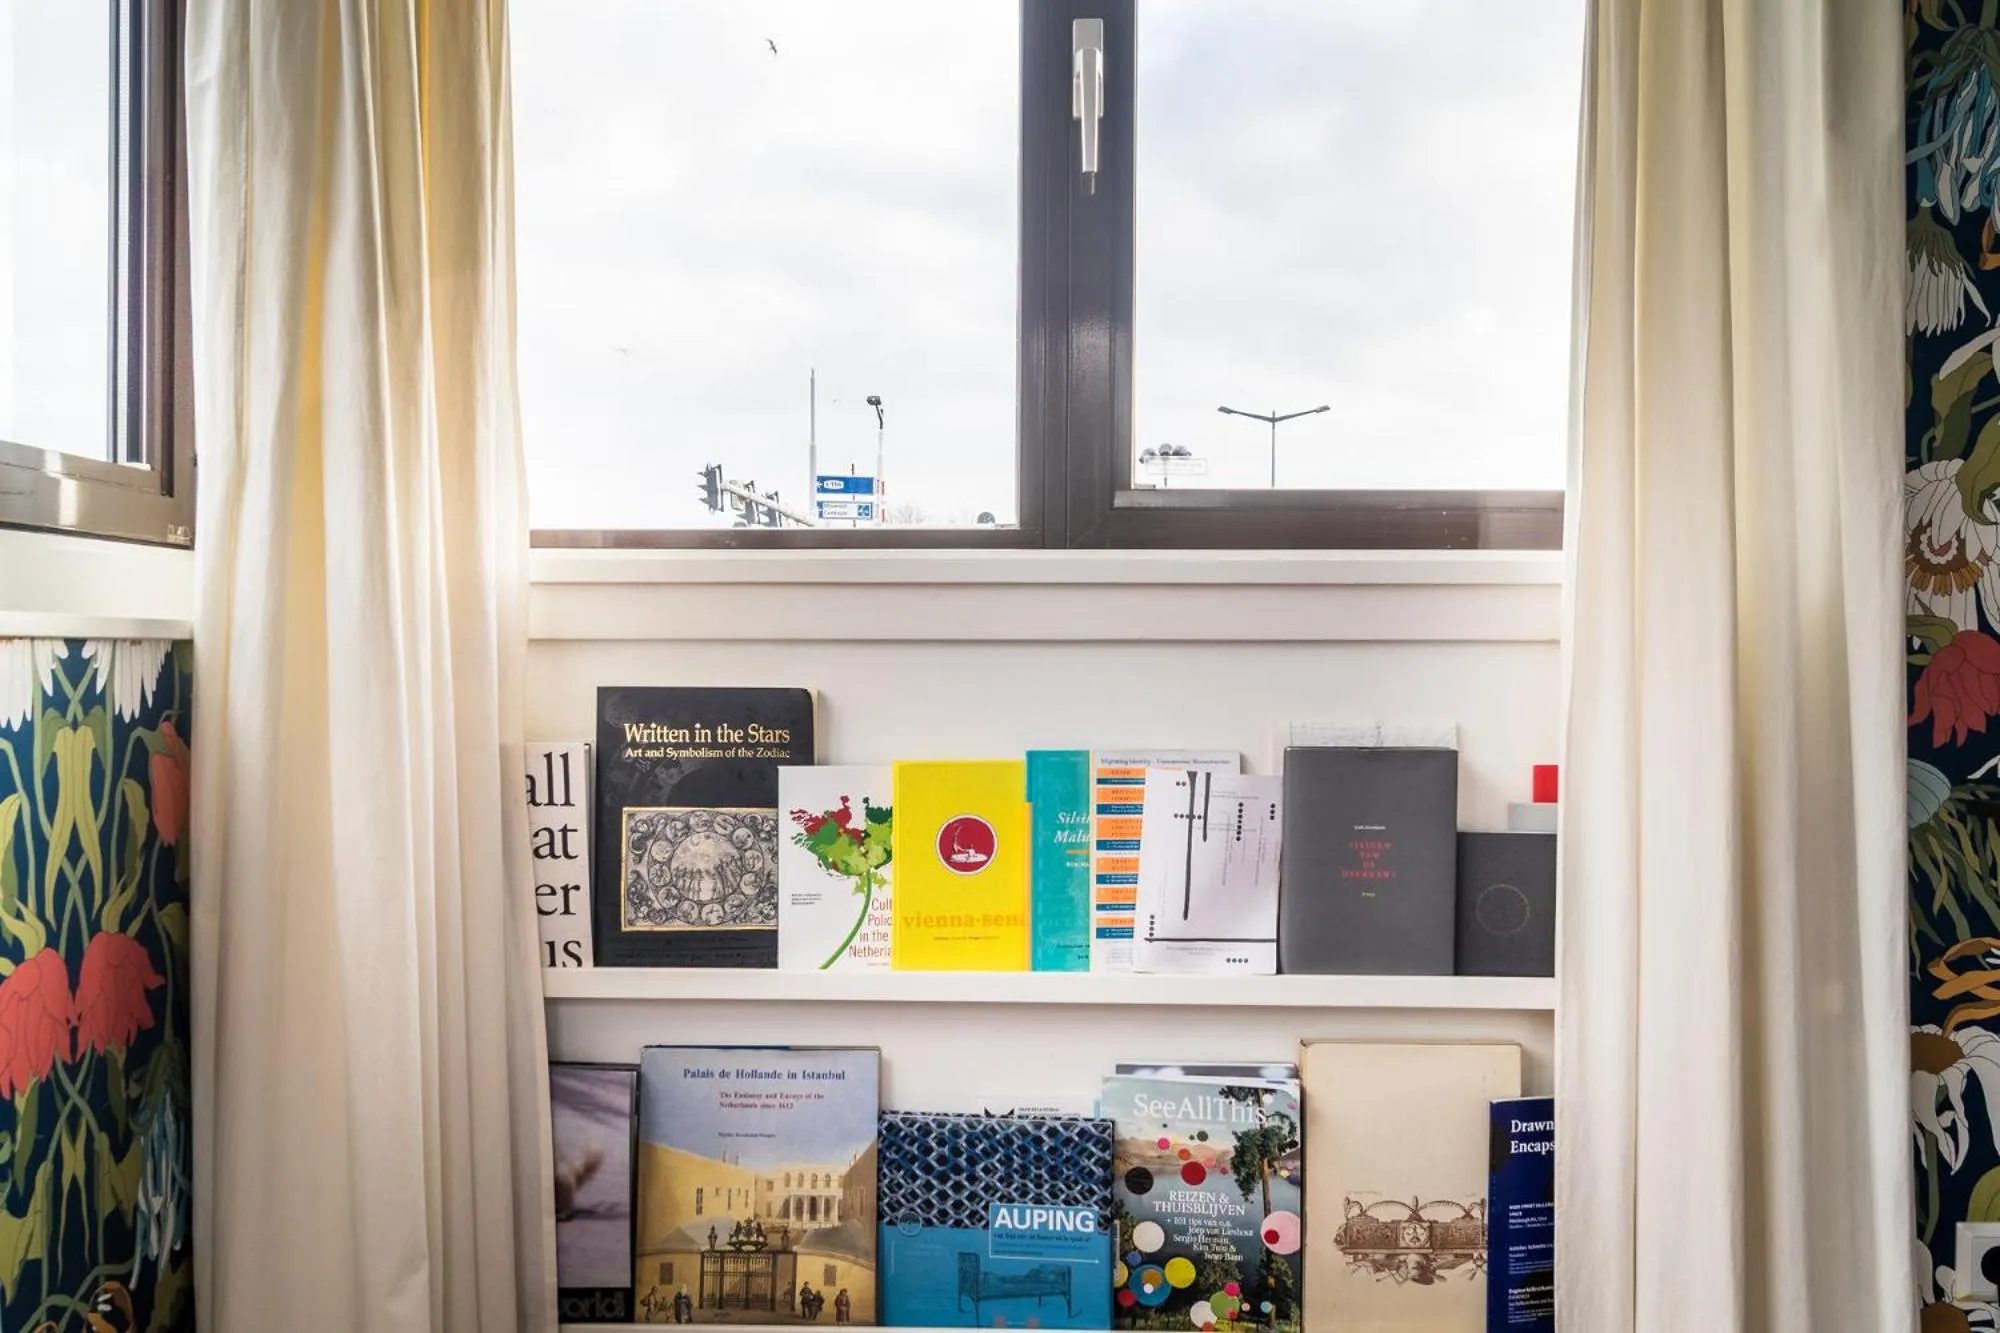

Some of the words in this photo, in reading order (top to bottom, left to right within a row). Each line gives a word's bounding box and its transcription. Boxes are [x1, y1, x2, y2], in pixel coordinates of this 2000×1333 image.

[624, 722, 690, 743] Written
[694, 722, 712, 743] in
[717, 723, 744, 743] the
[748, 723, 790, 743] Stars
[625, 748, 642, 758] Art
[644, 747, 664, 758] and
[666, 747, 723, 760] Symbolism
[725, 747, 736, 758] of
[738, 748, 753, 758] the
[757, 748, 790, 758] Zodiac
[533, 824, 578, 860] at
[859, 931, 869, 942] in
[872, 930, 889, 943] the
[683, 1068, 714, 1079] Palais
[718, 1068, 730, 1079] de
[735, 1069, 783, 1080] Hollande
[787, 1069, 797, 1080] in
[802, 1070, 846, 1080] Istanbul
[1133, 1091, 1268, 1124] SeeAllThis
[1510, 1119, 1555, 1133] Drawn
[1169, 1190, 1216, 1203] REIZEN
[1219, 1192, 1230, 1204] &
[1153, 1200, 1245, 1217] THUISBLIJVEN
[994, 1207, 1095, 1233] AUPING
